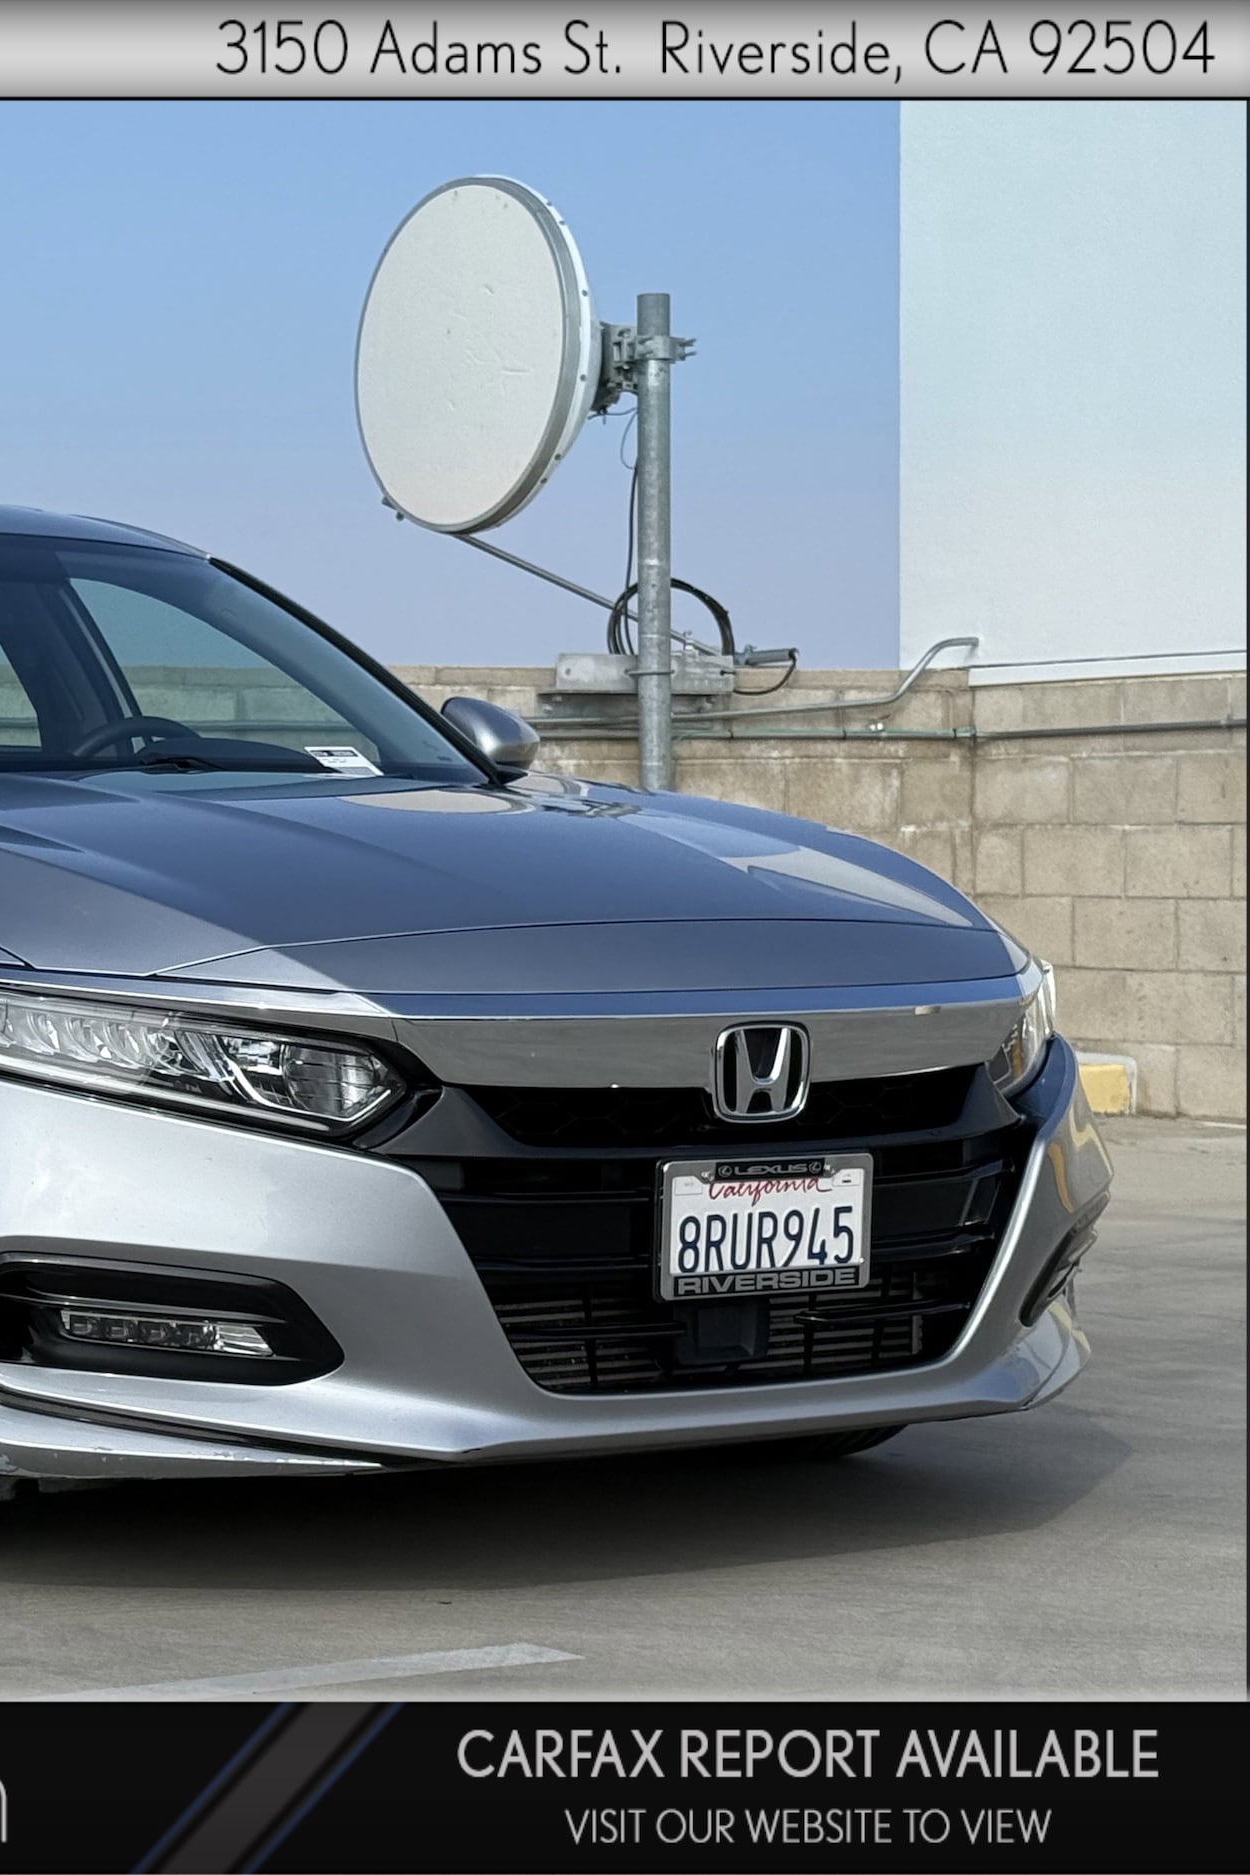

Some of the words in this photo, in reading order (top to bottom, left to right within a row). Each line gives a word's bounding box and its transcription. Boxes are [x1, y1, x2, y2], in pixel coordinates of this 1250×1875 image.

[734, 1162, 808, 1176] LEXUS
[677, 1205, 855, 1274] 8RUR945
[676, 1267, 857, 1296] RIVERSIDE
